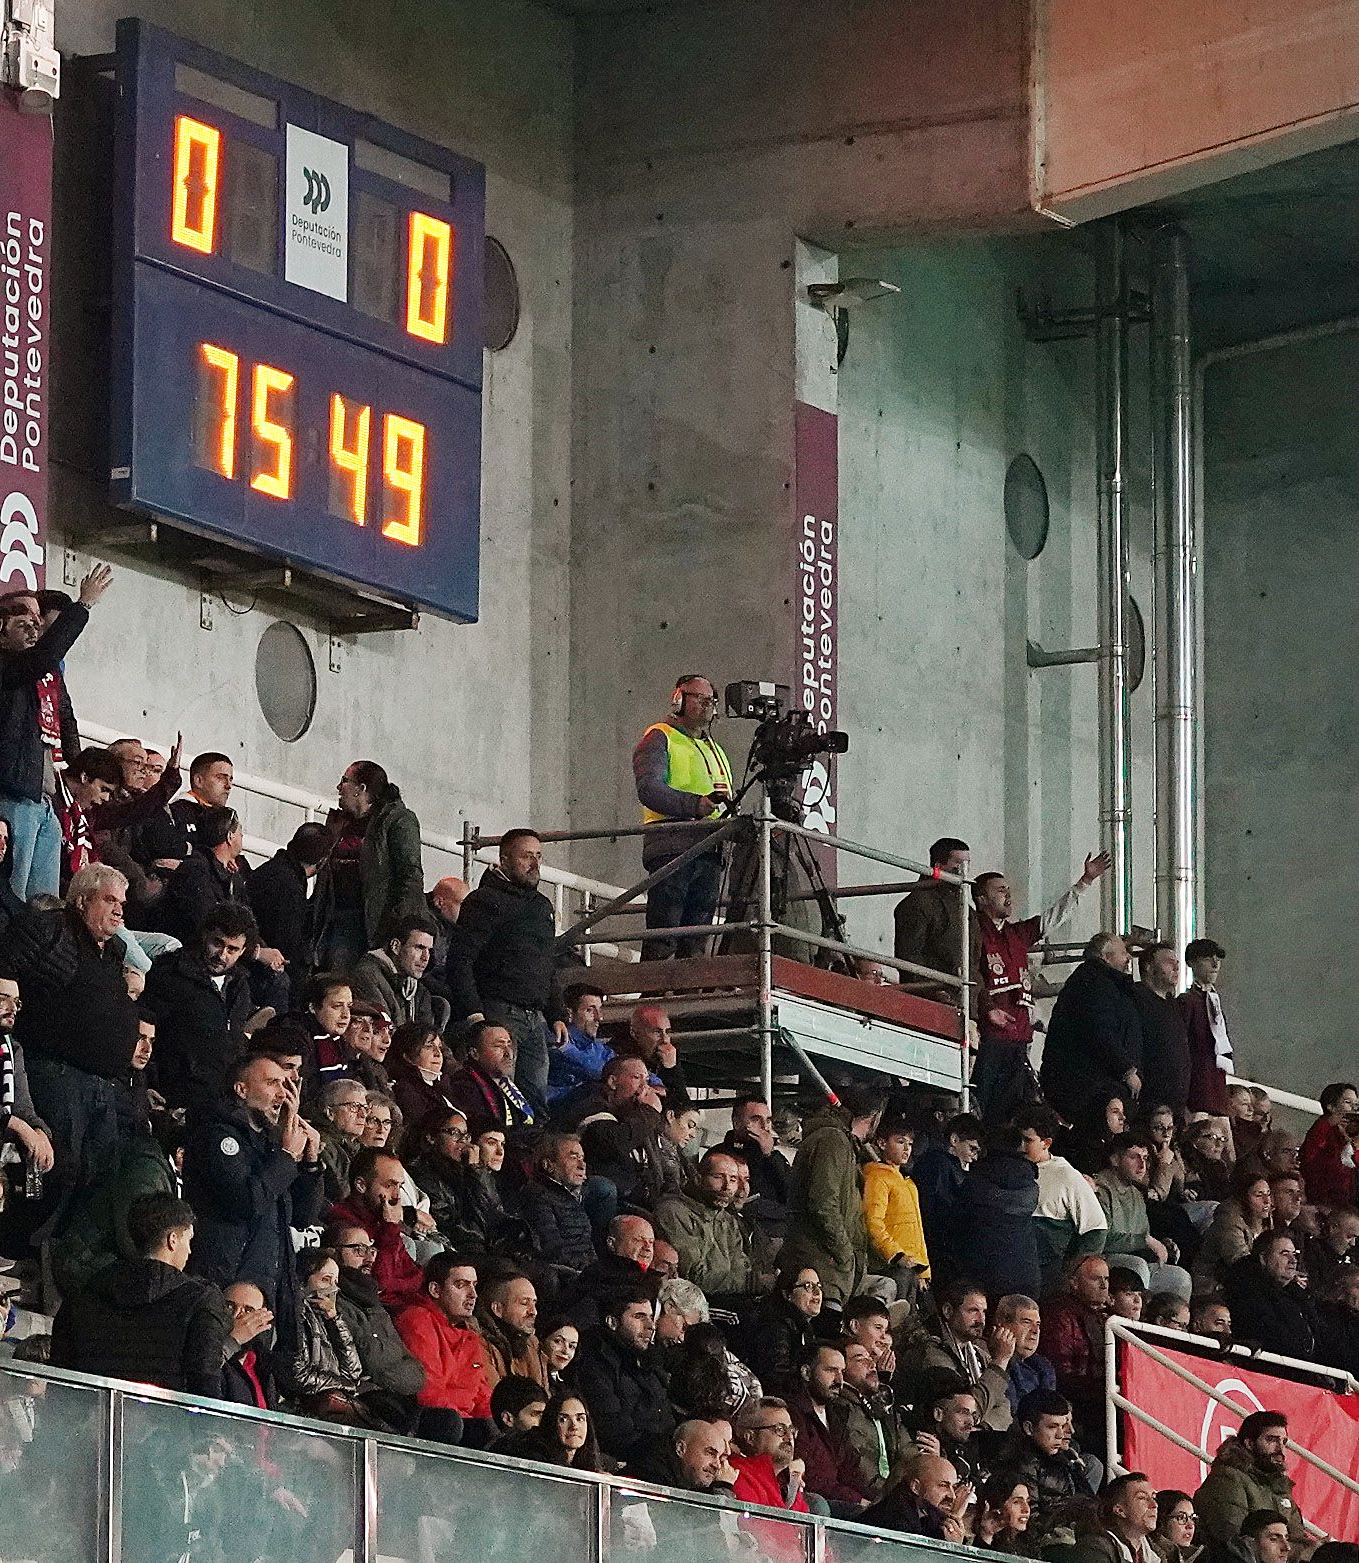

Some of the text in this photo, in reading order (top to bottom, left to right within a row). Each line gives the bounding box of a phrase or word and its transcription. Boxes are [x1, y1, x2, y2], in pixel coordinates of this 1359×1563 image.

[171, 114, 222, 255] 0
[291, 213, 342, 243] Deputación
[291, 229, 342, 258] Pontevedra
[0, 211, 25, 466] Deputación
[22, 217, 45, 473] Pontevedra
[405, 210, 451, 345] 0
[200, 342, 426, 547] 75 49
[799, 514, 819, 729] eputación
